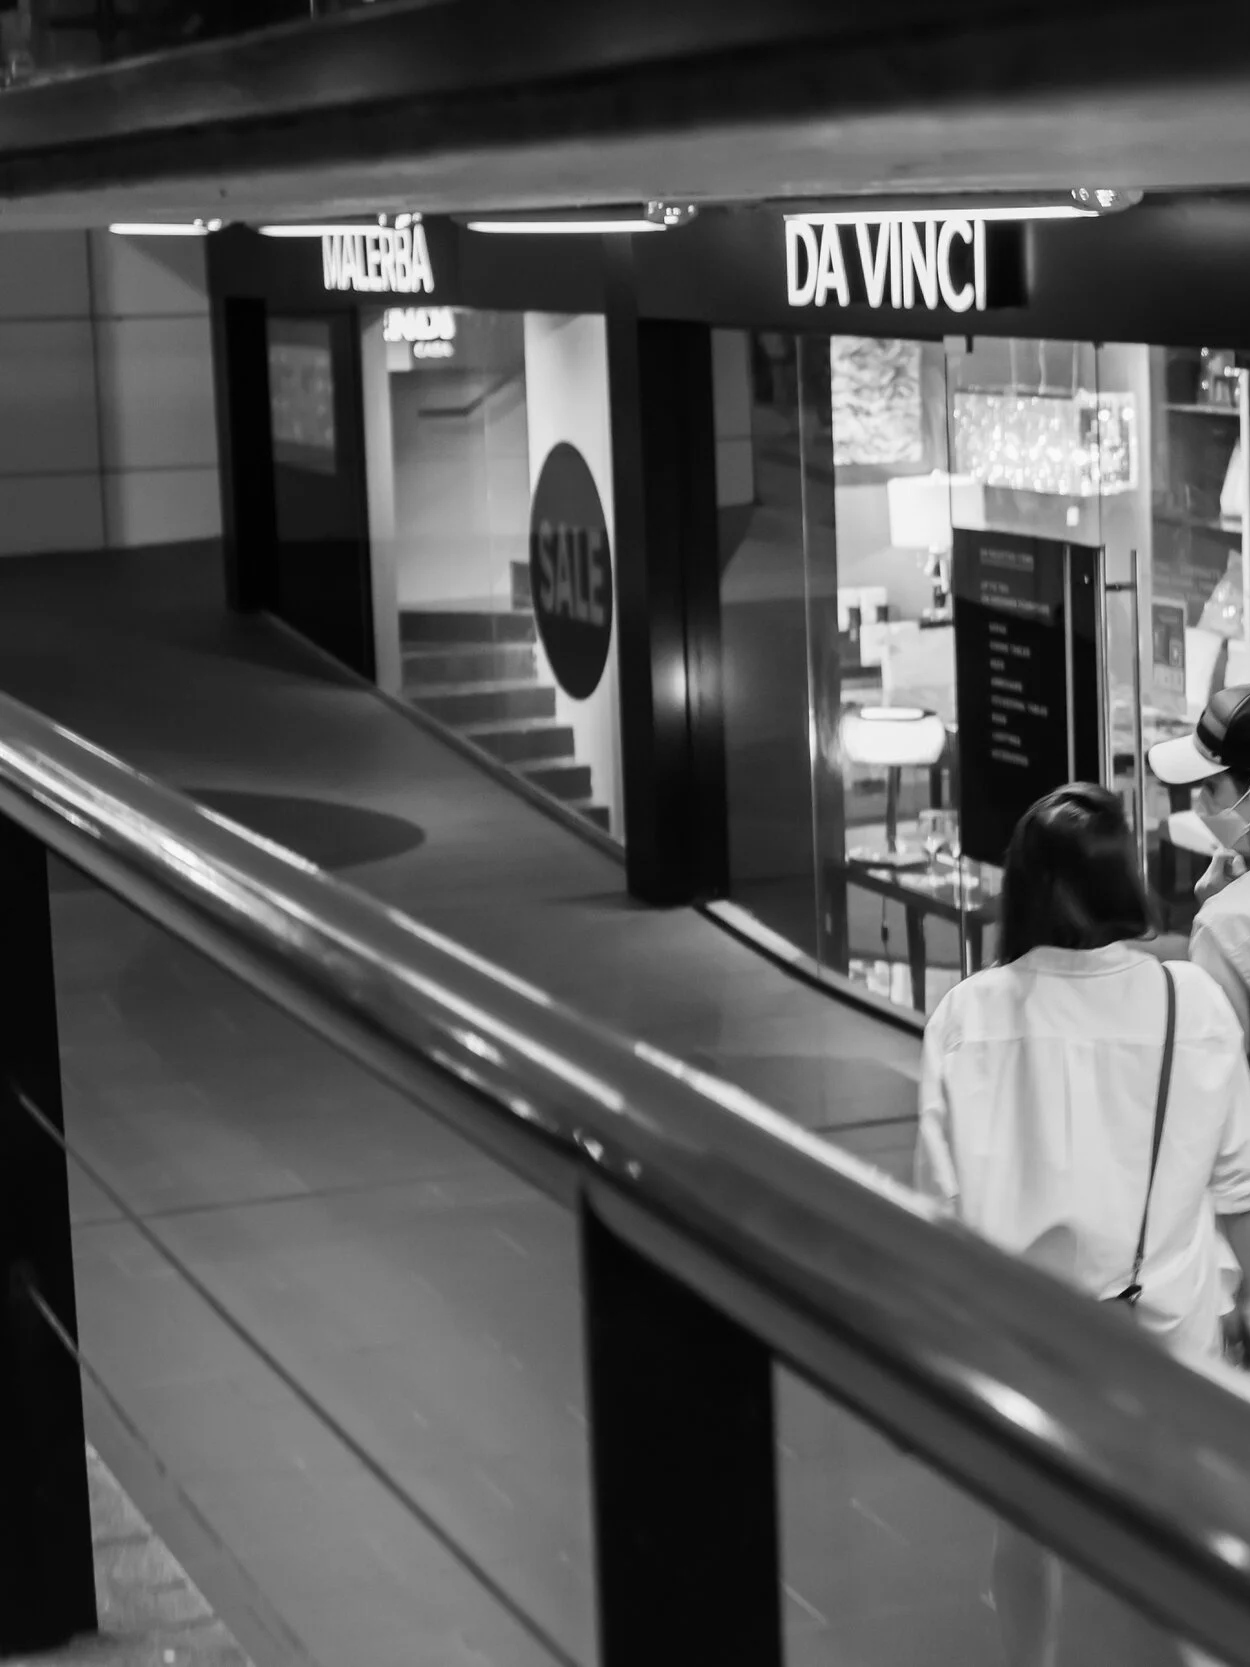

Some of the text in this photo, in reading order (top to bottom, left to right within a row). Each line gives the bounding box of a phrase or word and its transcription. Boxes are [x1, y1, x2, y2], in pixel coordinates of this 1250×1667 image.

[321, 222, 434, 293] MALERBA
[785, 217, 986, 312] DA VINCI
[538, 519, 605, 627] SALE
